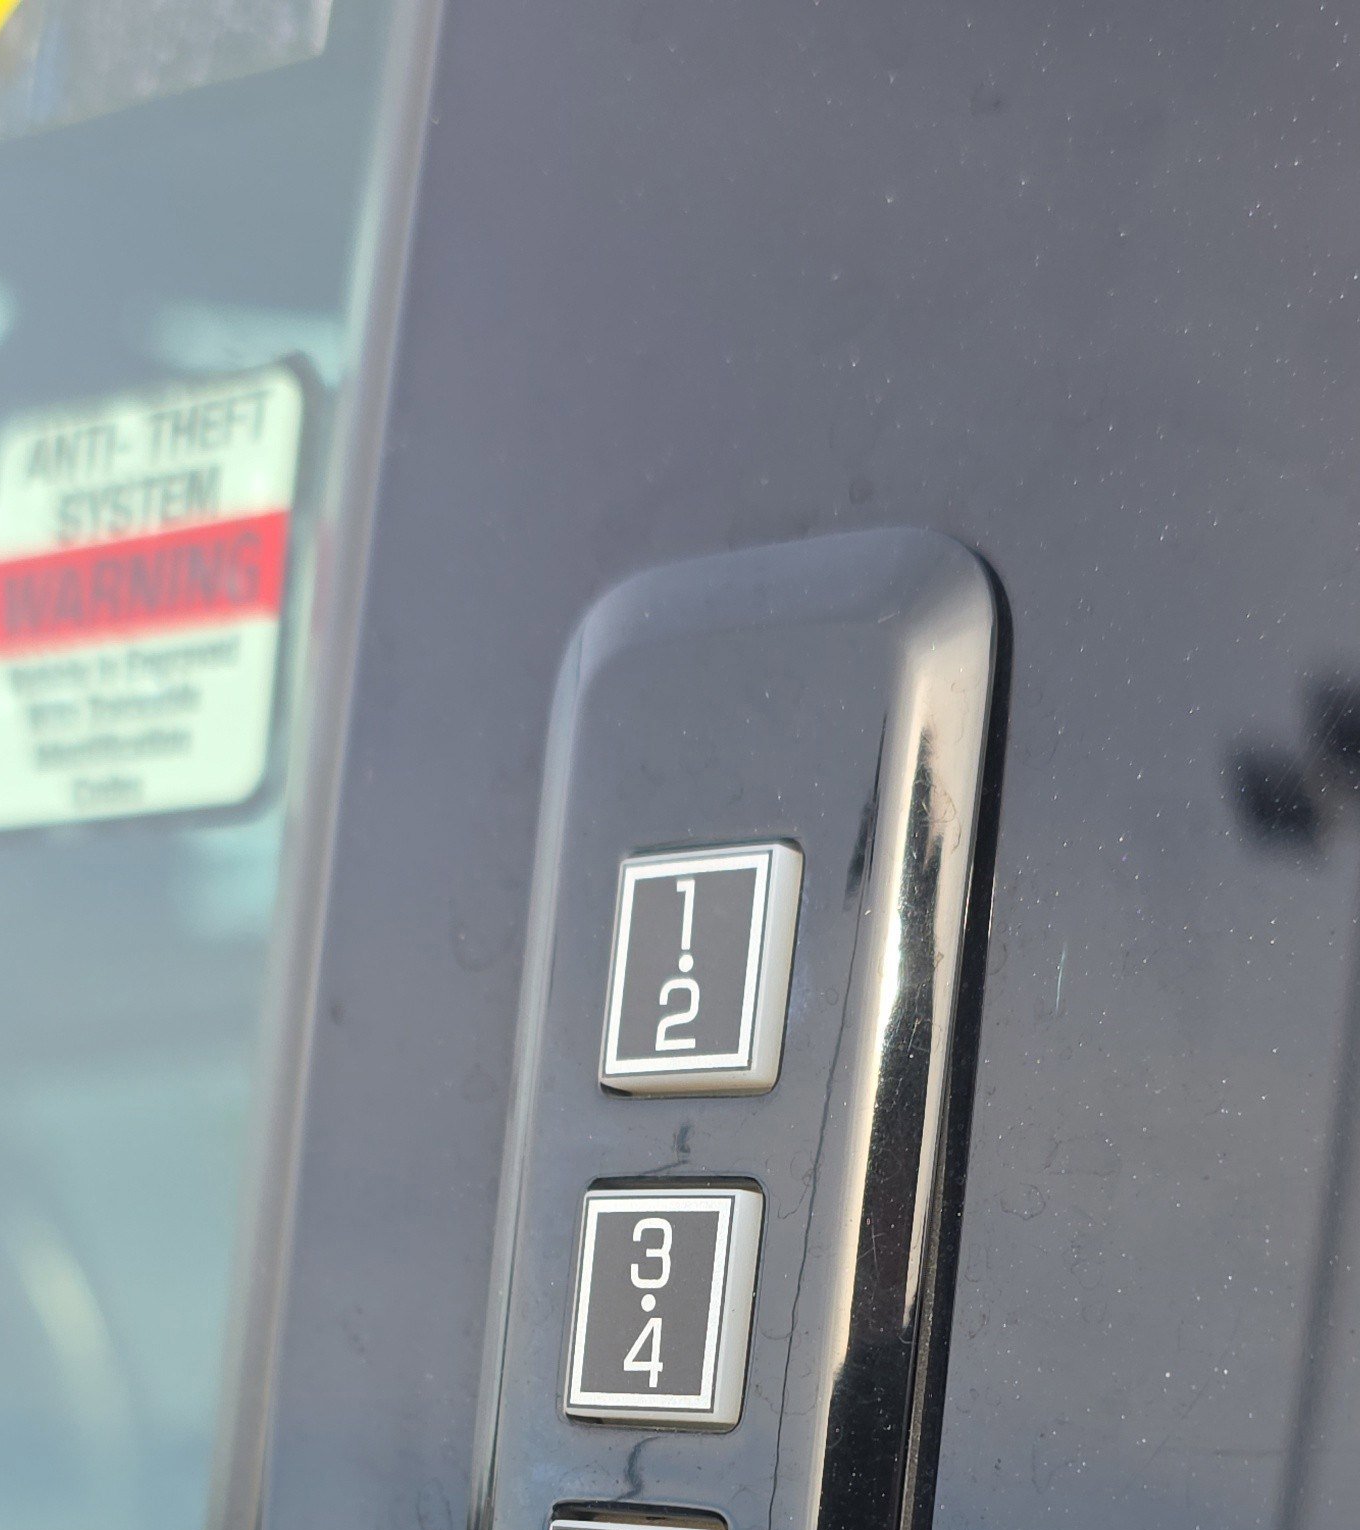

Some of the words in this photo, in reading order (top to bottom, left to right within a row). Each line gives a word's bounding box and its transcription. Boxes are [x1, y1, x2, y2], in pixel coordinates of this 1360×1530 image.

[56, 465, 222, 545] SYSTEM
[2, 530, 262, 637] WARNING
[676, 879, 696, 951] 1
[655, 977, 700, 1052] 2
[630, 1217, 673, 1289] 3
[623, 1317, 664, 1388] 4
